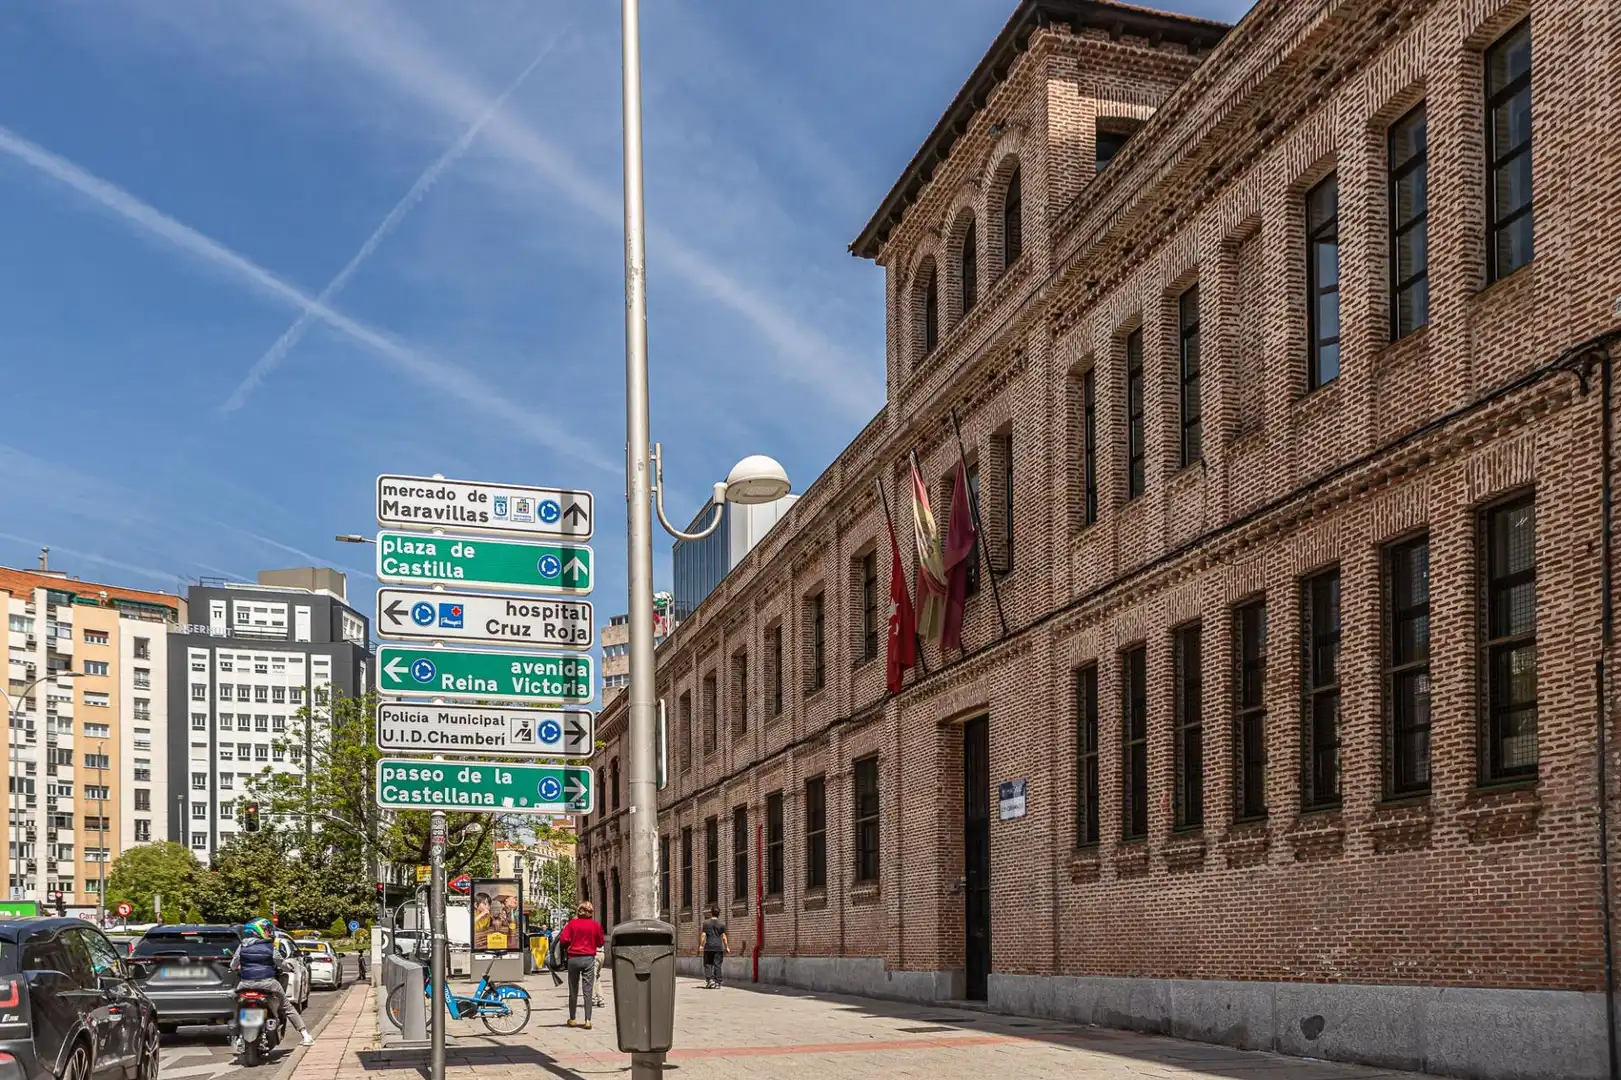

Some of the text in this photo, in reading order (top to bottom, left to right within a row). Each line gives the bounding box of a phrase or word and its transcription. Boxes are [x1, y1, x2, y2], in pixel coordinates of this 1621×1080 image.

[383, 486, 488, 503] mercado de
[382, 500, 489, 523] Maravillas
[383, 538, 476, 559] plaza de
[382, 557, 464, 579] Castilla
[506, 601, 588, 621] hospital
[485, 619, 588, 643] Cruz Roja
[511, 661, 588, 677] avenida
[441, 673, 588, 696] Reina Victoria
[382, 711, 506, 727] Policía Municipal
[382, 767, 513, 785] paseo de la
[382, 785, 495, 805] Castellana
